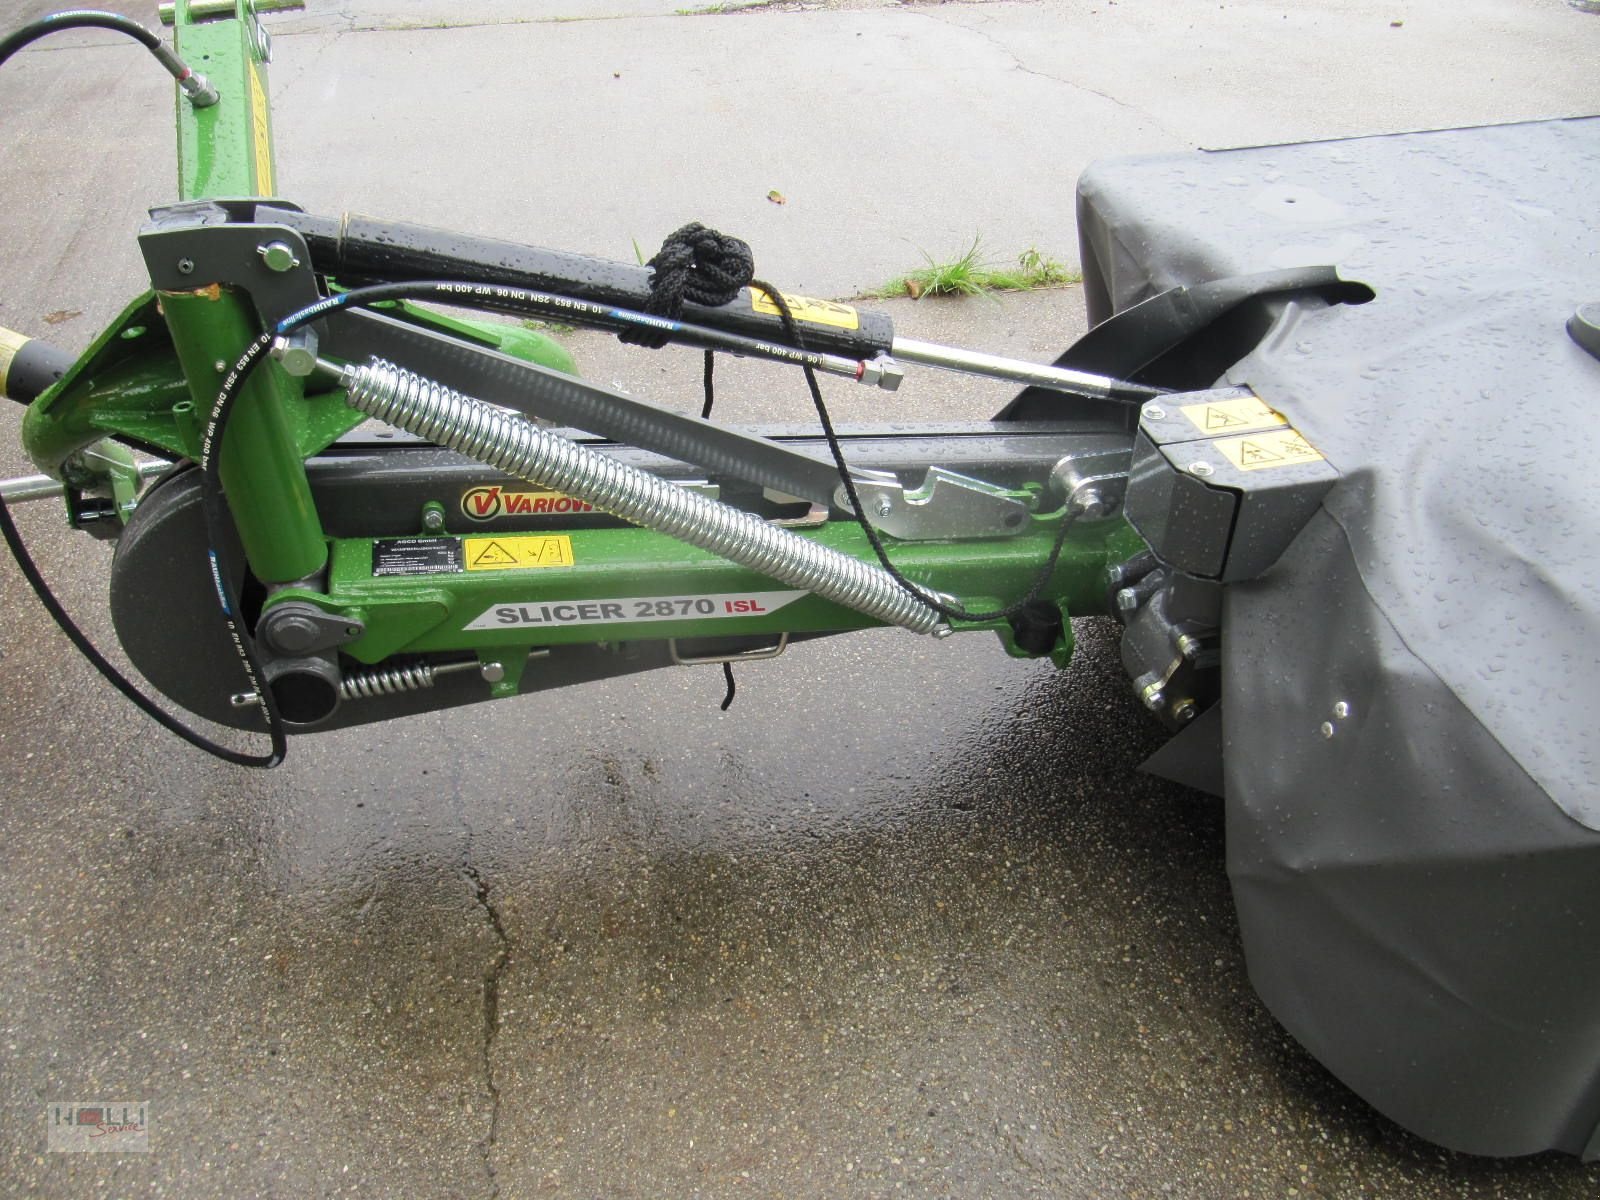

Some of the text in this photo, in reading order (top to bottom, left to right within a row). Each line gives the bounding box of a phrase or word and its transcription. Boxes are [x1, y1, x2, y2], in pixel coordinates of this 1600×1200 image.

[436, 283, 453, 293] bar
[455, 286, 472, 294] 400
[475, 287, 491, 296] WP
[497, 289, 509, 298] 06
[511, 291, 525, 300] DN
[530, 295, 550, 305] 2SN
[554, 298, 571, 308] 853
[573, 300, 587, 312] EN
[592, 305, 602, 314] 10
[260, 332, 272, 344] 10
[247, 342, 261, 357] EN
[755, 343, 770, 353] bar
[771, 346, 788, 357] 400
[789, 351, 803, 361] WP
[236, 356, 250, 371] 853
[224, 371, 238, 391] 2SN
[216, 392, 227, 408] DN
[211, 408, 221, 419] 06
[207, 421, 217, 438] WP
[204, 437, 212, 455] 400
[201, 454, 210, 472] bar
[495, 599, 766, 624] SLICER 2870 ISL
